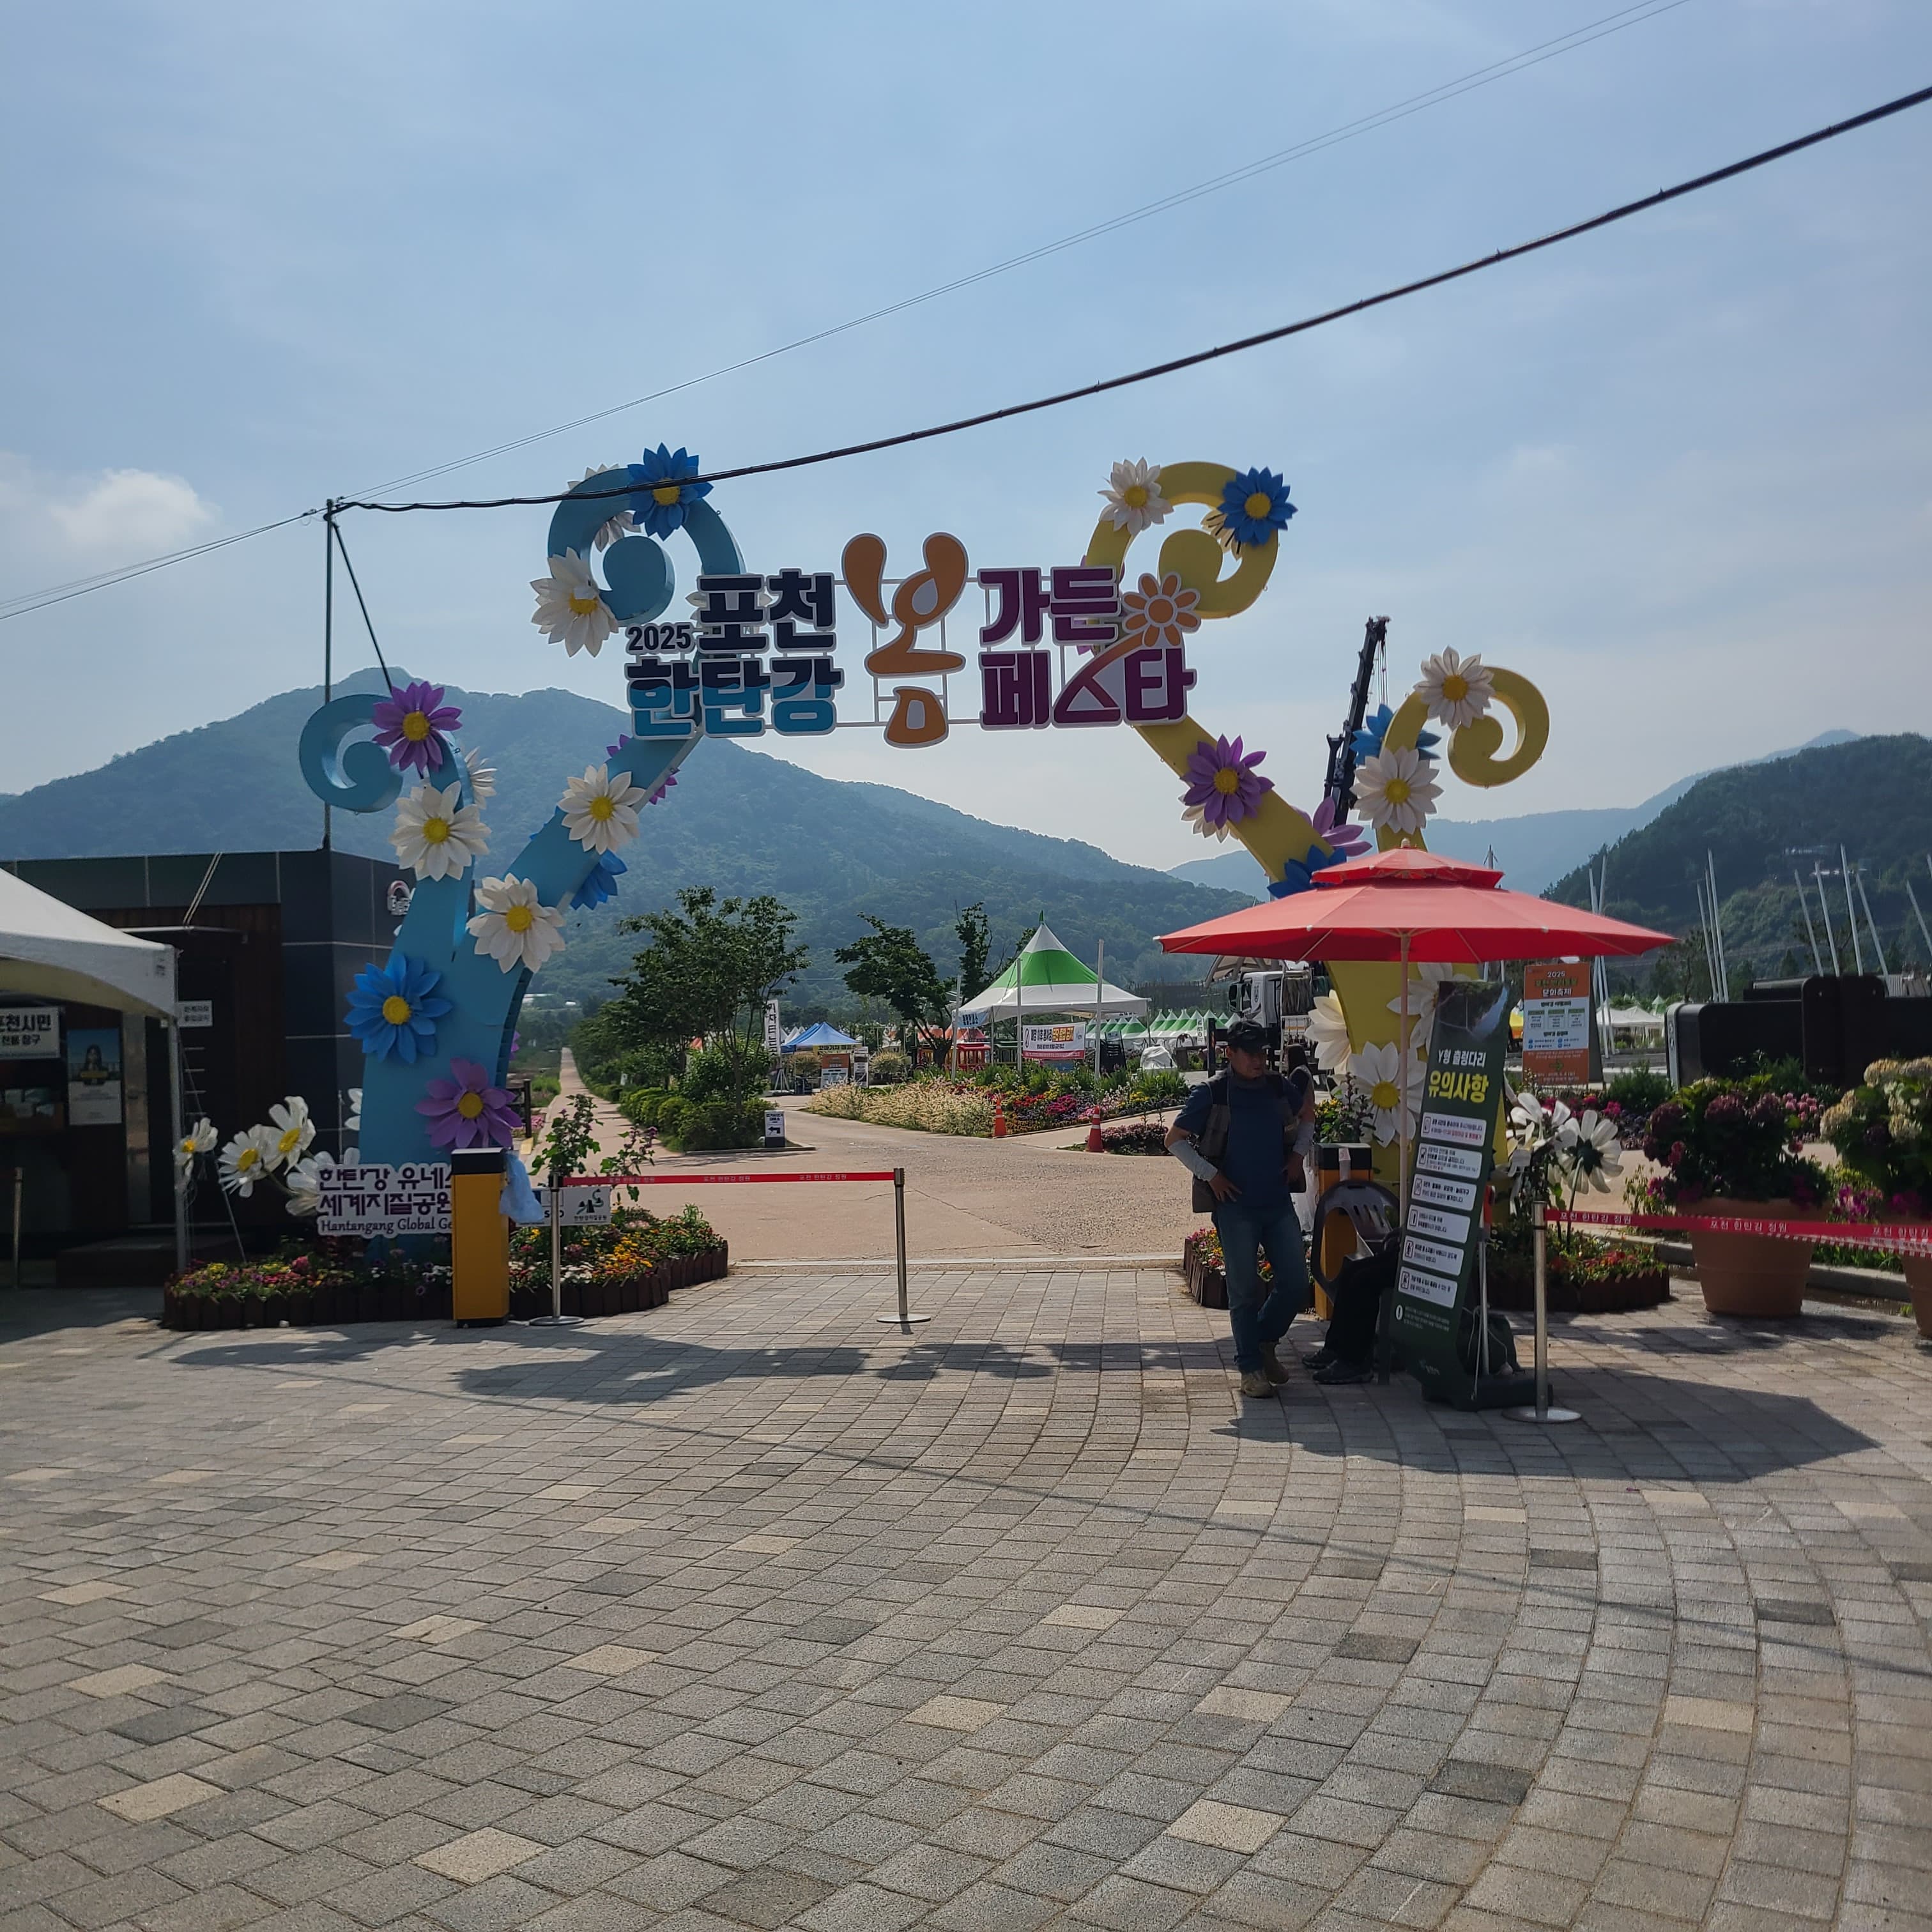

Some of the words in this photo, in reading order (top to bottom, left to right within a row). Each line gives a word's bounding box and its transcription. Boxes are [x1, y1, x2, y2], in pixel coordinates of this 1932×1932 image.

[628, 627, 691, 652] 2025
[698, 567, 836, 654] 포천
[841, 532, 969, 748] 봄
[978, 566, 1121, 647] 가든
[626, 656, 844, 740] 한탄강
[979, 644, 1196, 730] 페스타
[1429, 1070, 1489, 1103] 유의사항
[1439, 1048, 1451, 1065] Y형
[1453, 1050, 1487, 1068] 출렁다리
[319, 1167, 390, 1191] 한탄강
[321, 1220, 394, 1234] Hantangang
[397, 1216, 435, 1230] Global
